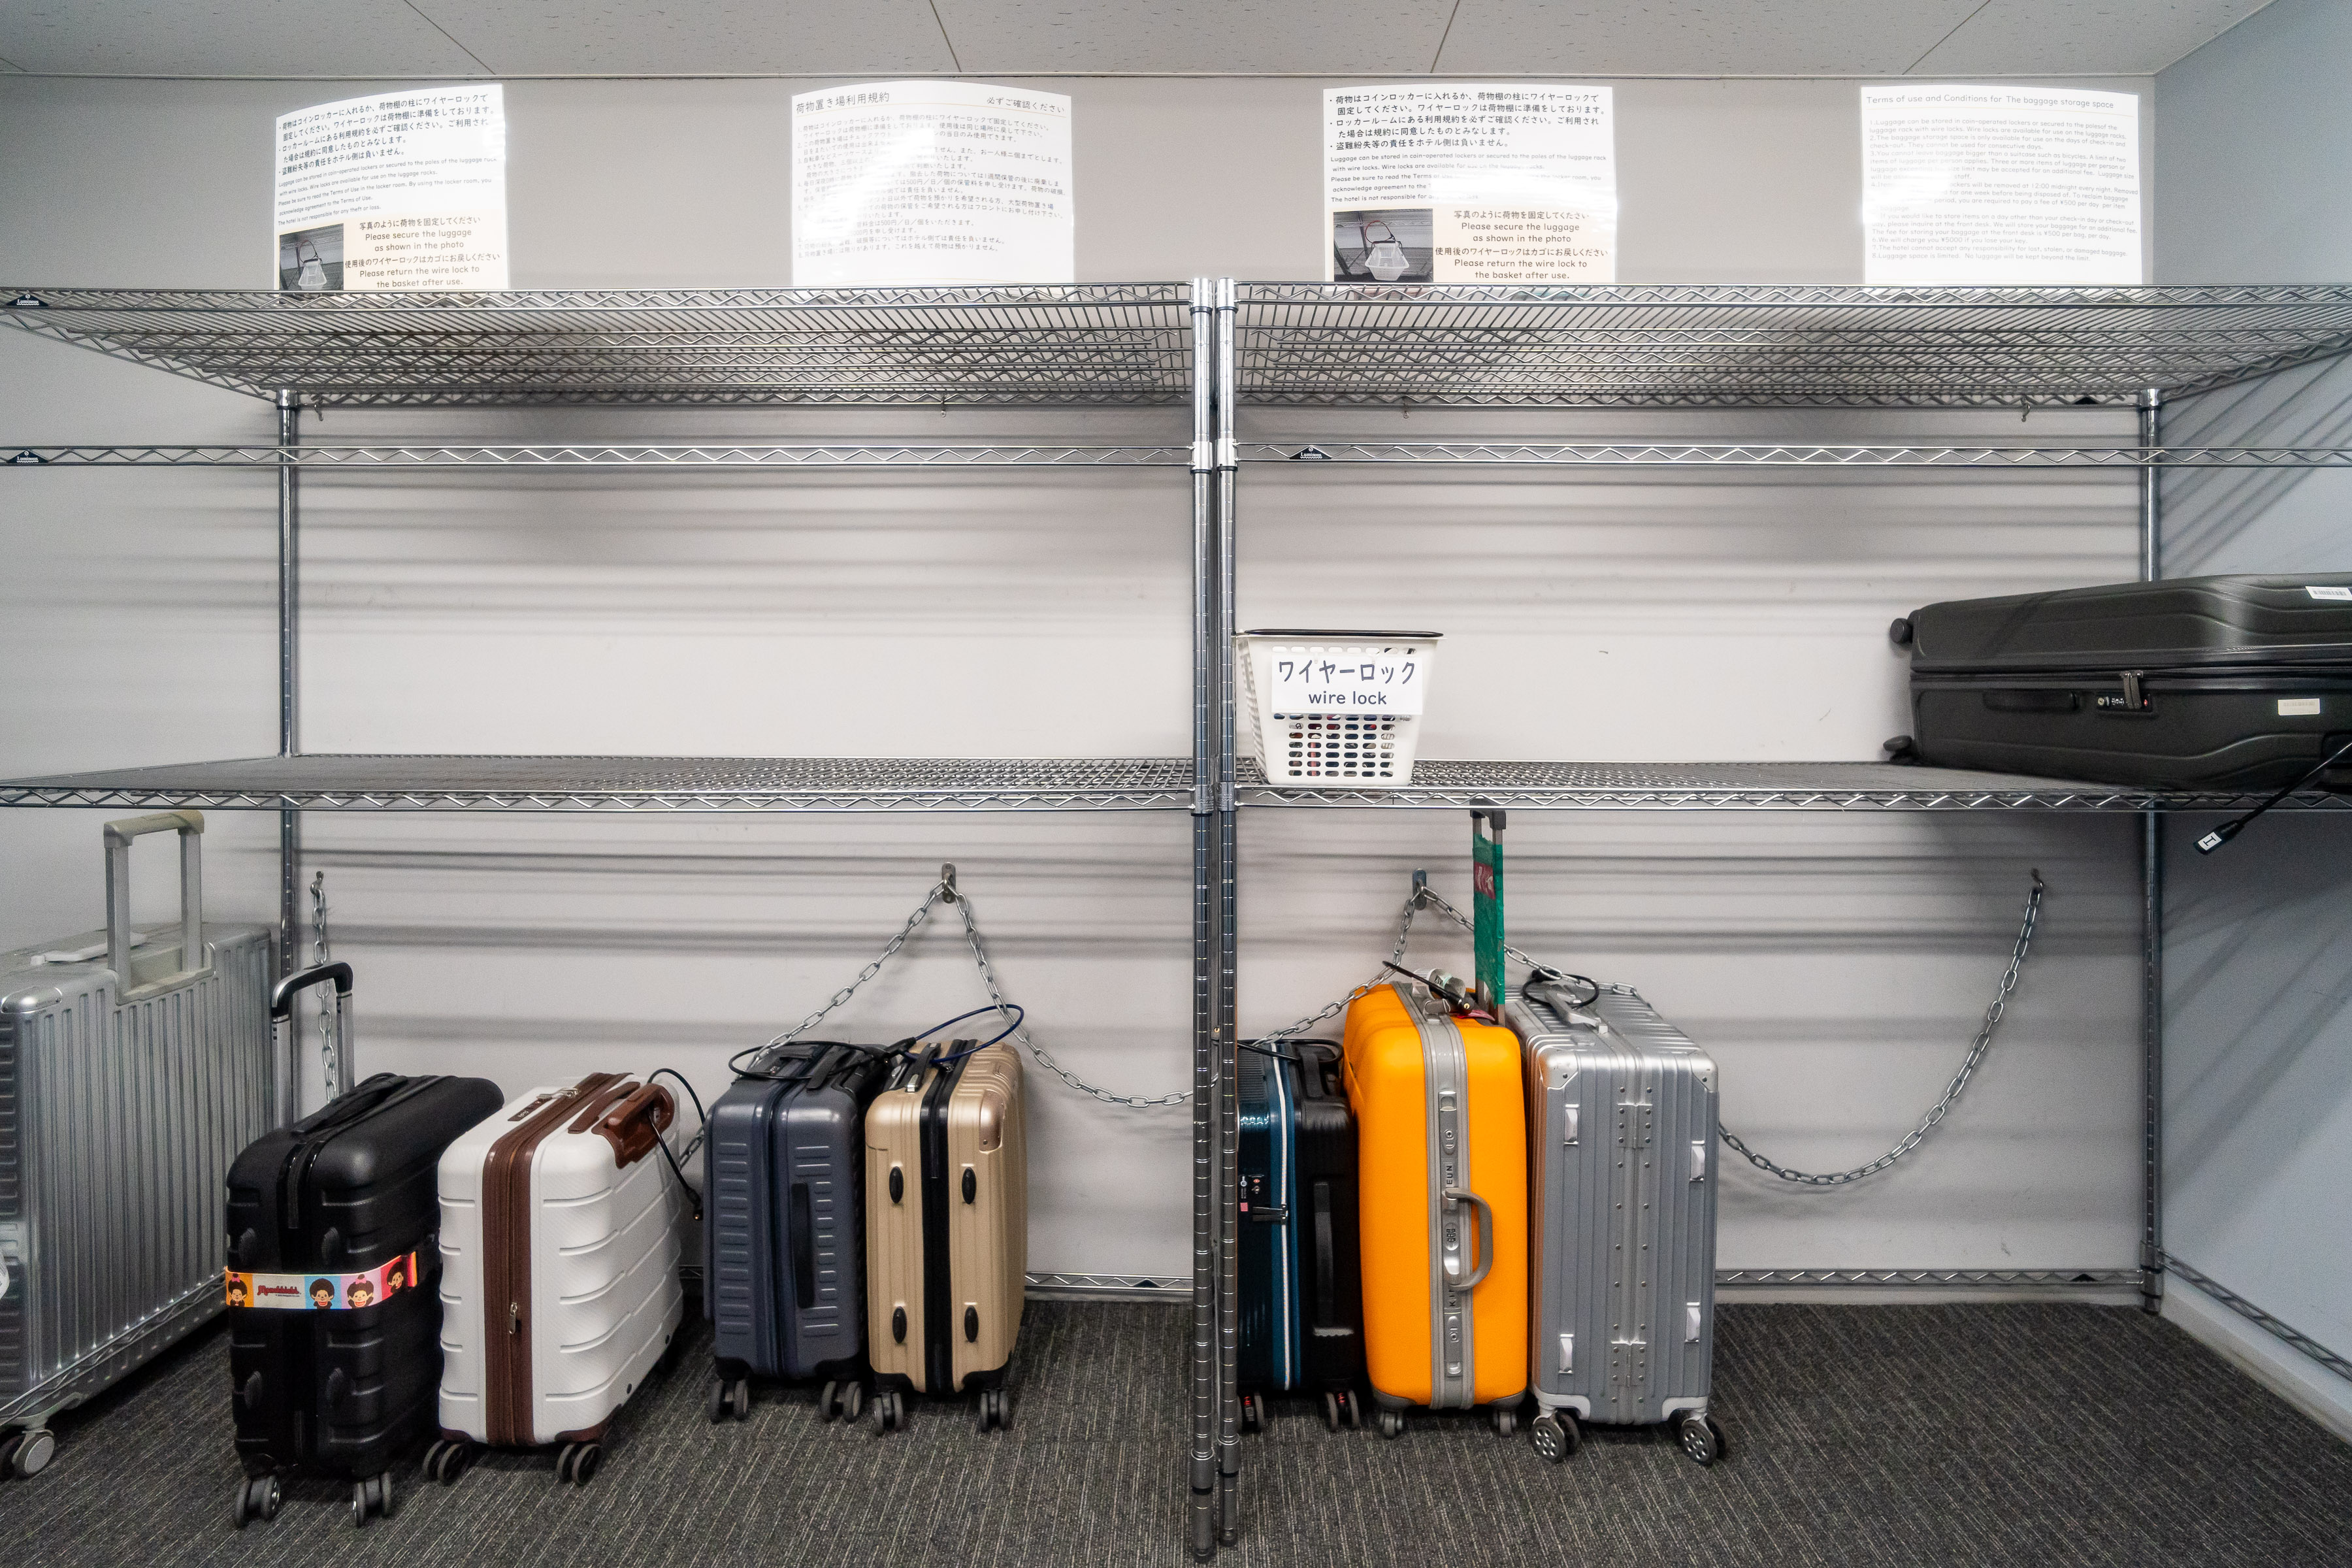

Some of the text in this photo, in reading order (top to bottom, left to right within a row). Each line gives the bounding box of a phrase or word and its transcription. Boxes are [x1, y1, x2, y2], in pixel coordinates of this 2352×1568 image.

[2023, 96, 2058, 106] baggage
[2061, 99, 2090, 108] storage
[1544, 223, 1580, 233] luggage
[438, 230, 472, 238] luggage
[1546, 235, 1571, 244] photo
[440, 241, 464, 250] photo
[1279, 660, 1415, 685] ワイヤーロック
[1309, 691, 1387, 706] wire lock
